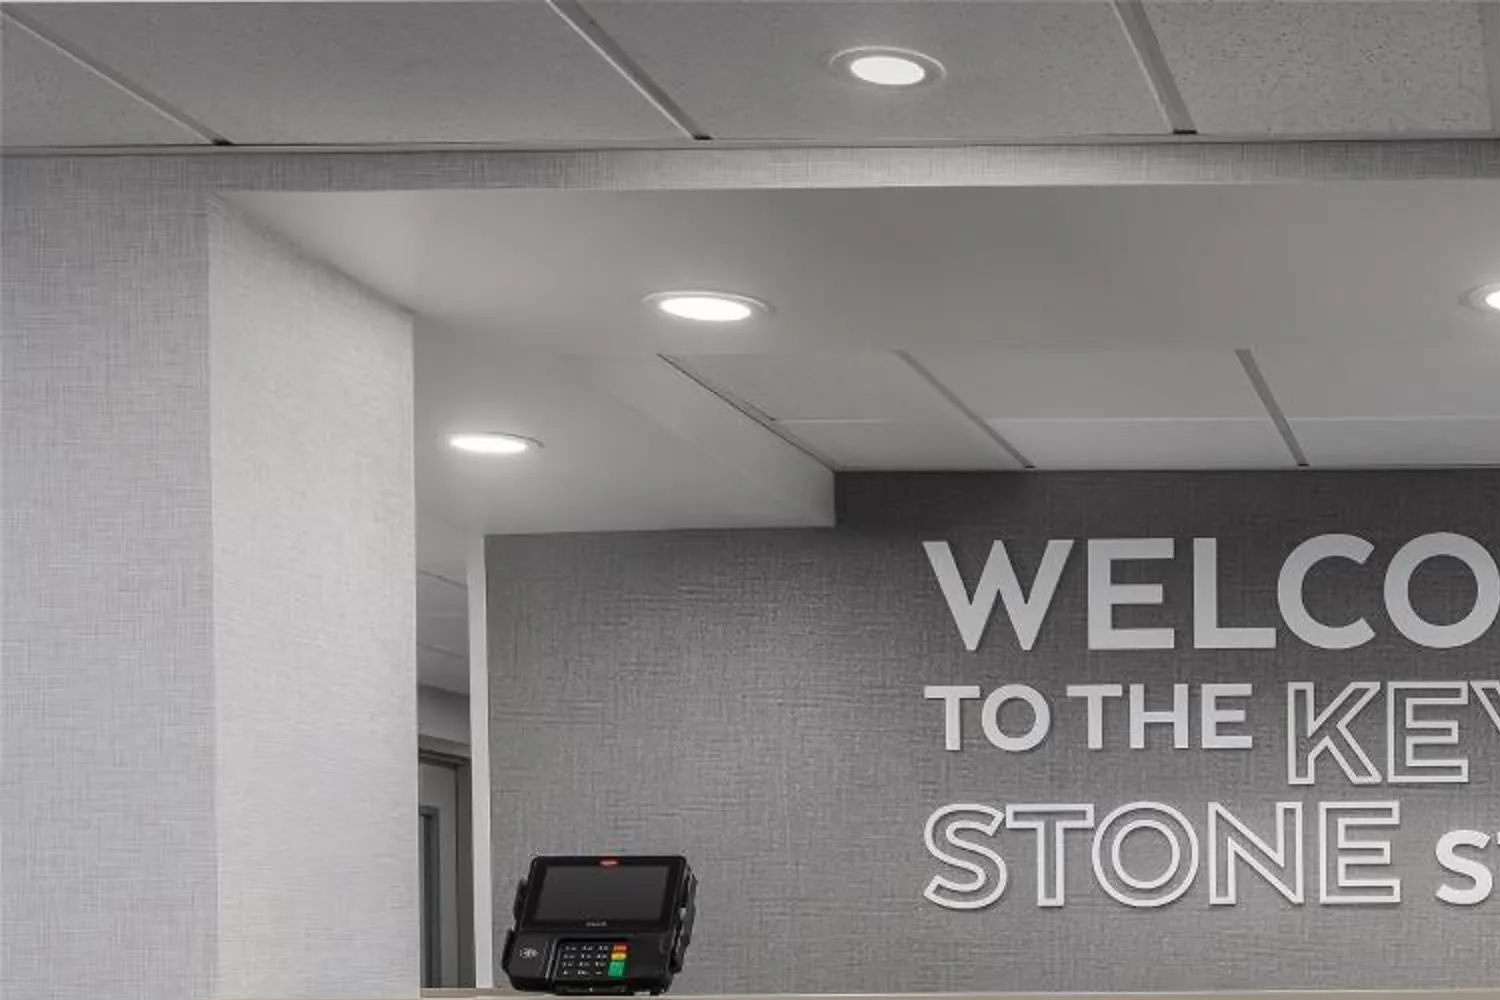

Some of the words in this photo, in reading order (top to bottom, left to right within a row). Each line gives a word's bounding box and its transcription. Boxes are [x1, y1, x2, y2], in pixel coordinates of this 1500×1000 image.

[924, 683, 1051, 752] TO
[1067, 682, 1254, 750] THE
[923, 801, 1400, 909] STONE
